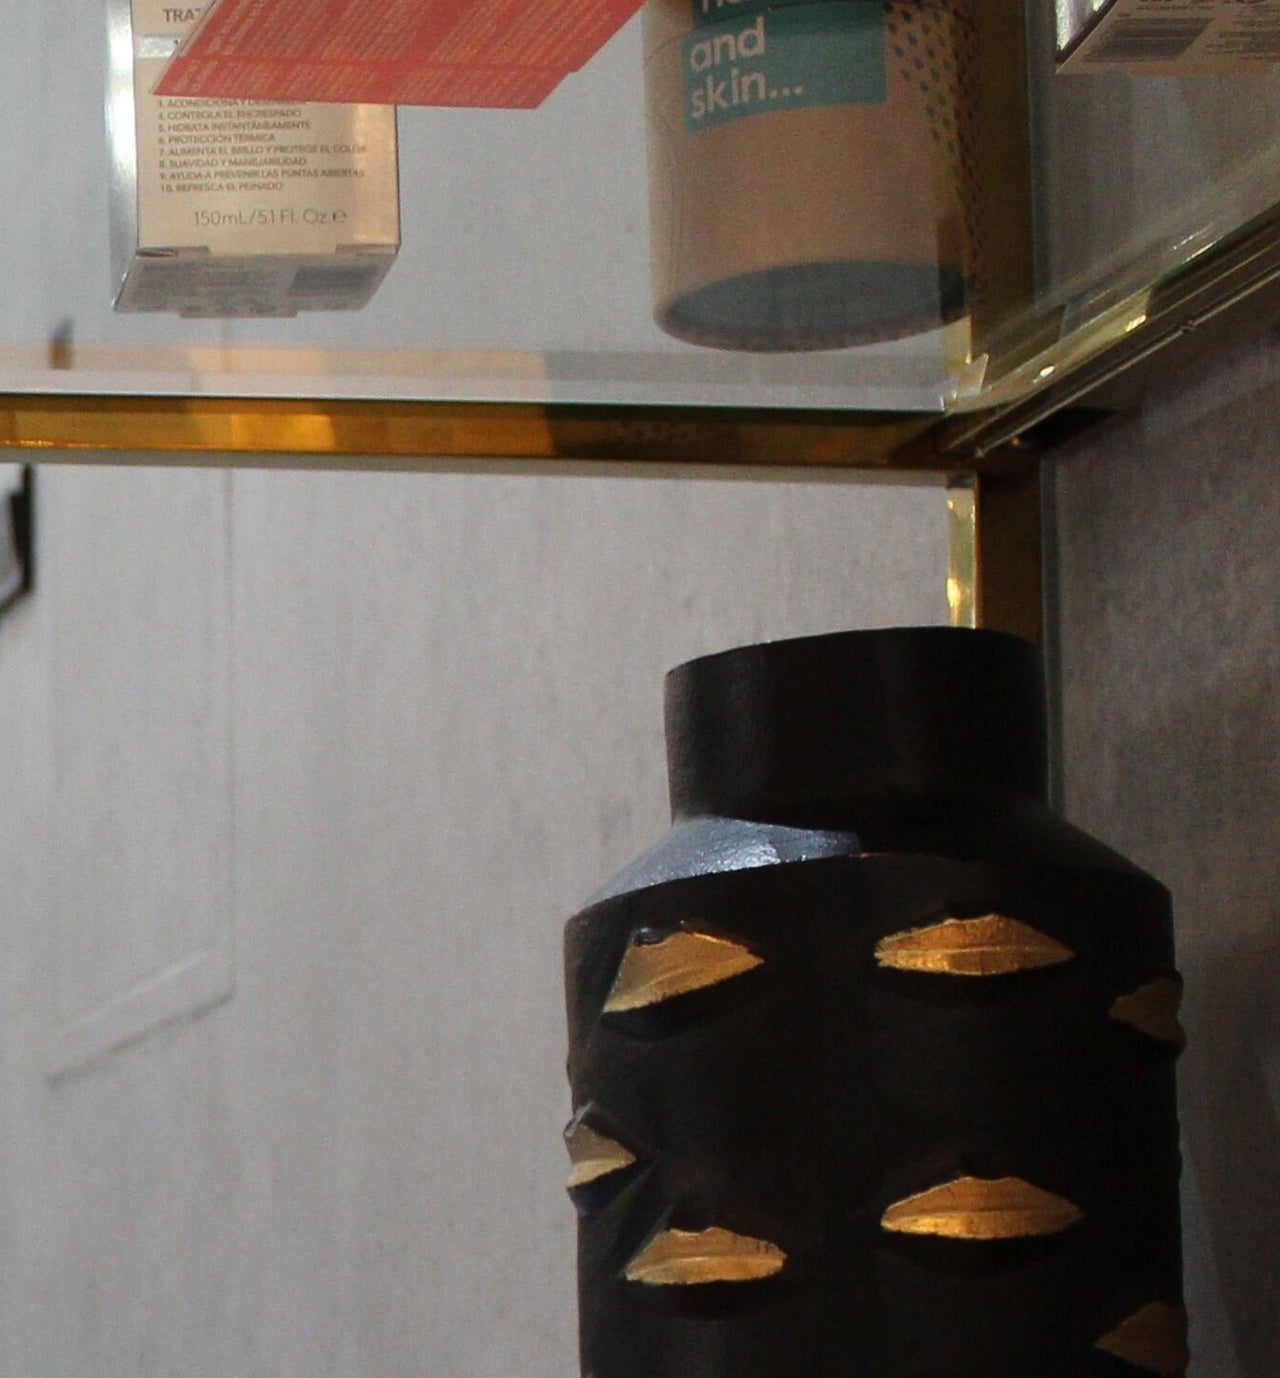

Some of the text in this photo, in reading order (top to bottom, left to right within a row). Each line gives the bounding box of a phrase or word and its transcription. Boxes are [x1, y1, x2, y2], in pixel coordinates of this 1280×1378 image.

[162, 7, 200, 23] TRA
[690, 15, 765, 72] and
[690, 66, 804, 119] skin...
